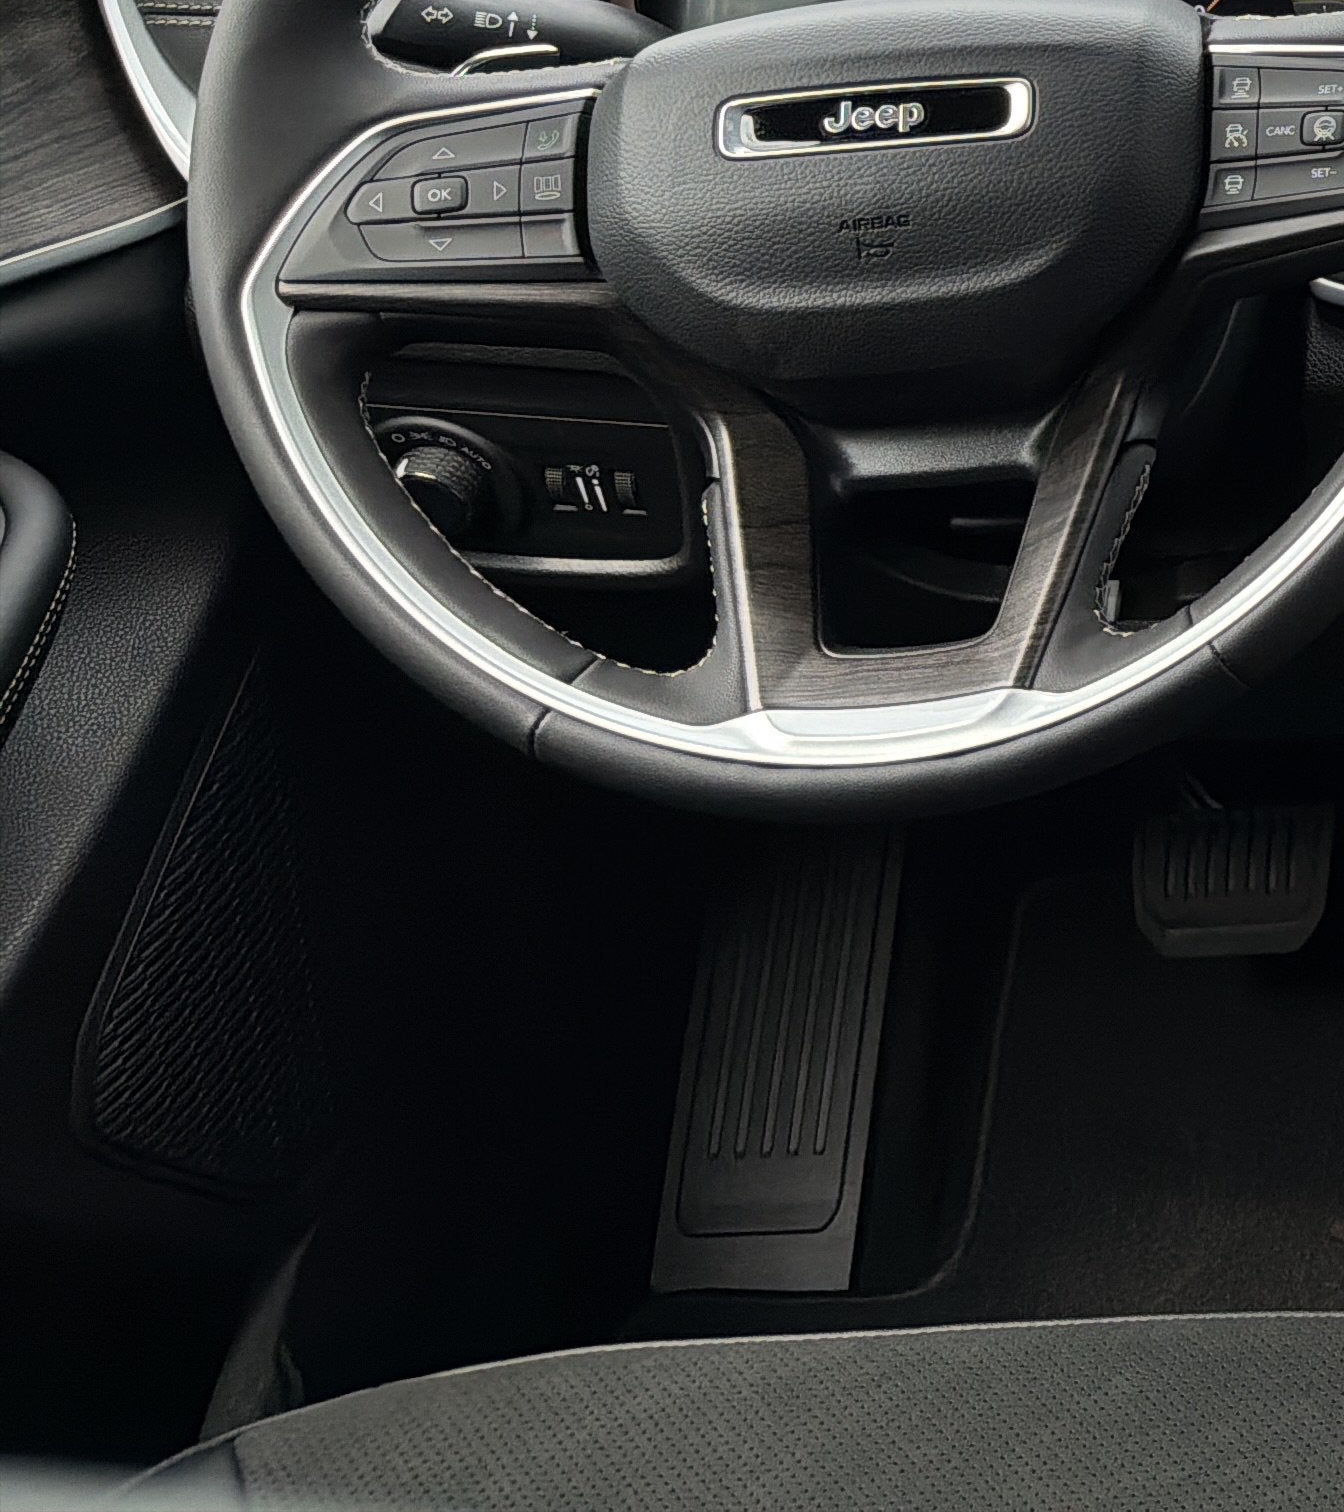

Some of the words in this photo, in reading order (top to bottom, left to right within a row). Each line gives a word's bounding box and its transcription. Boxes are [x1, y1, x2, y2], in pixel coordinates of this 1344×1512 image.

[823, 101, 925, 134] Jeep
[1266, 124, 1295, 137] CANC
[427, 188, 453, 202] OK
[838, 213, 911, 234] AIRBAG
[460, 446, 492, 471] AUTO
